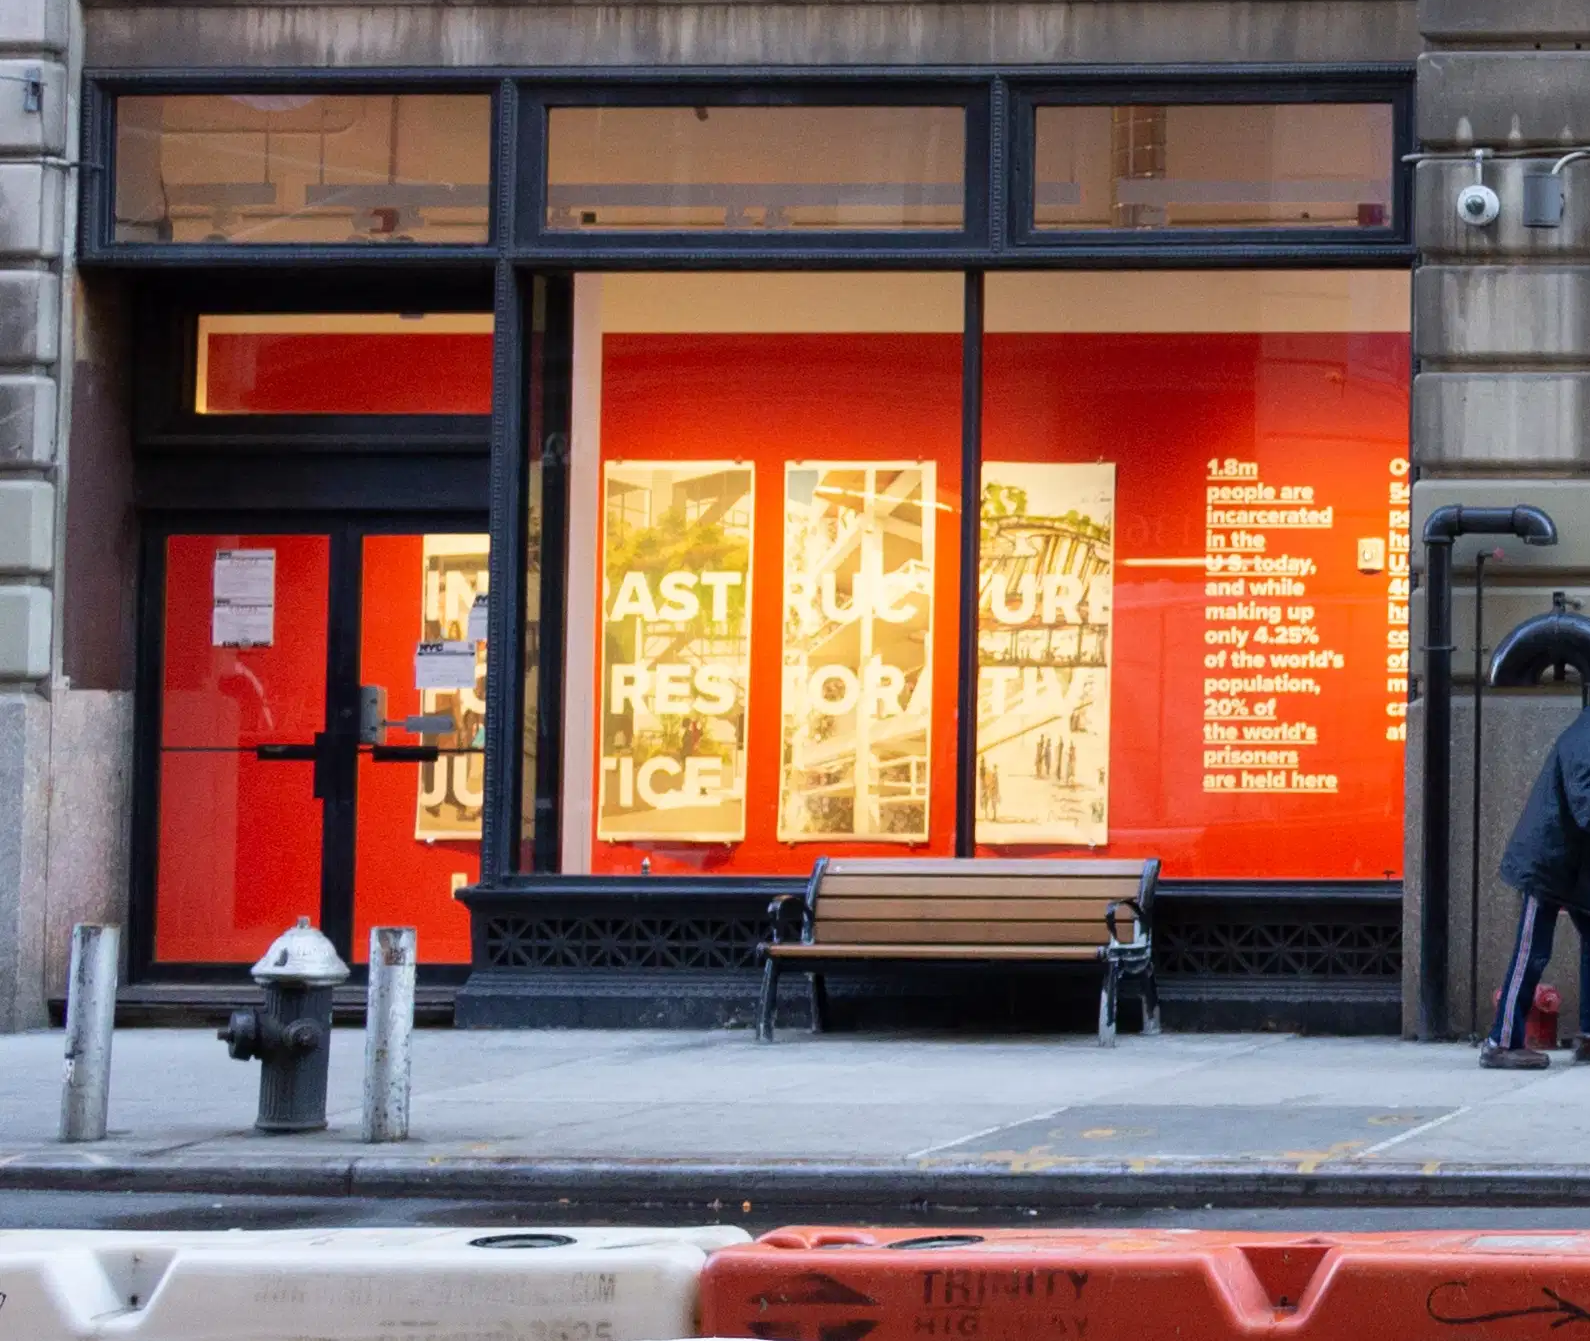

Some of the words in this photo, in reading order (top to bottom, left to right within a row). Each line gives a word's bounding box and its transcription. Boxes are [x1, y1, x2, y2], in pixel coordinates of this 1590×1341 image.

[1206, 457, 1259, 477] 1.8m
[1206, 483, 1276, 503] people
[1280, 485, 1315, 500] are
[1206, 505, 1333, 525] incarcerated
[1206, 529, 1226, 548] in
[1230, 530, 1266, 548] the
[1253, 554, 1317, 575] today,
[603, 570, 743, 623] AST
[1204, 578, 1245, 596] and
[1249, 578, 1305, 596] while
[1205, 601, 1282, 624] making
[1287, 606, 1315, 624] up
[1204, 626, 1249, 649] only
[1253, 626, 1320, 645] 4.25%
[1204, 649, 1228, 669] of
[1230, 650, 1266, 669] the
[1270, 649, 1345, 669] world's
[1203, 673, 1321, 696] population,
[1203, 697, 1250, 717] 20%
[1253, 697, 1278, 717] of
[1203, 722, 1239, 740] the
[1243, 722, 1318, 740] world's
[1203, 745, 1299, 767] prisoners
[1203, 773, 1237, 789] are
[1241, 770, 1287, 789] held
[1291, 770, 1338, 789] here
